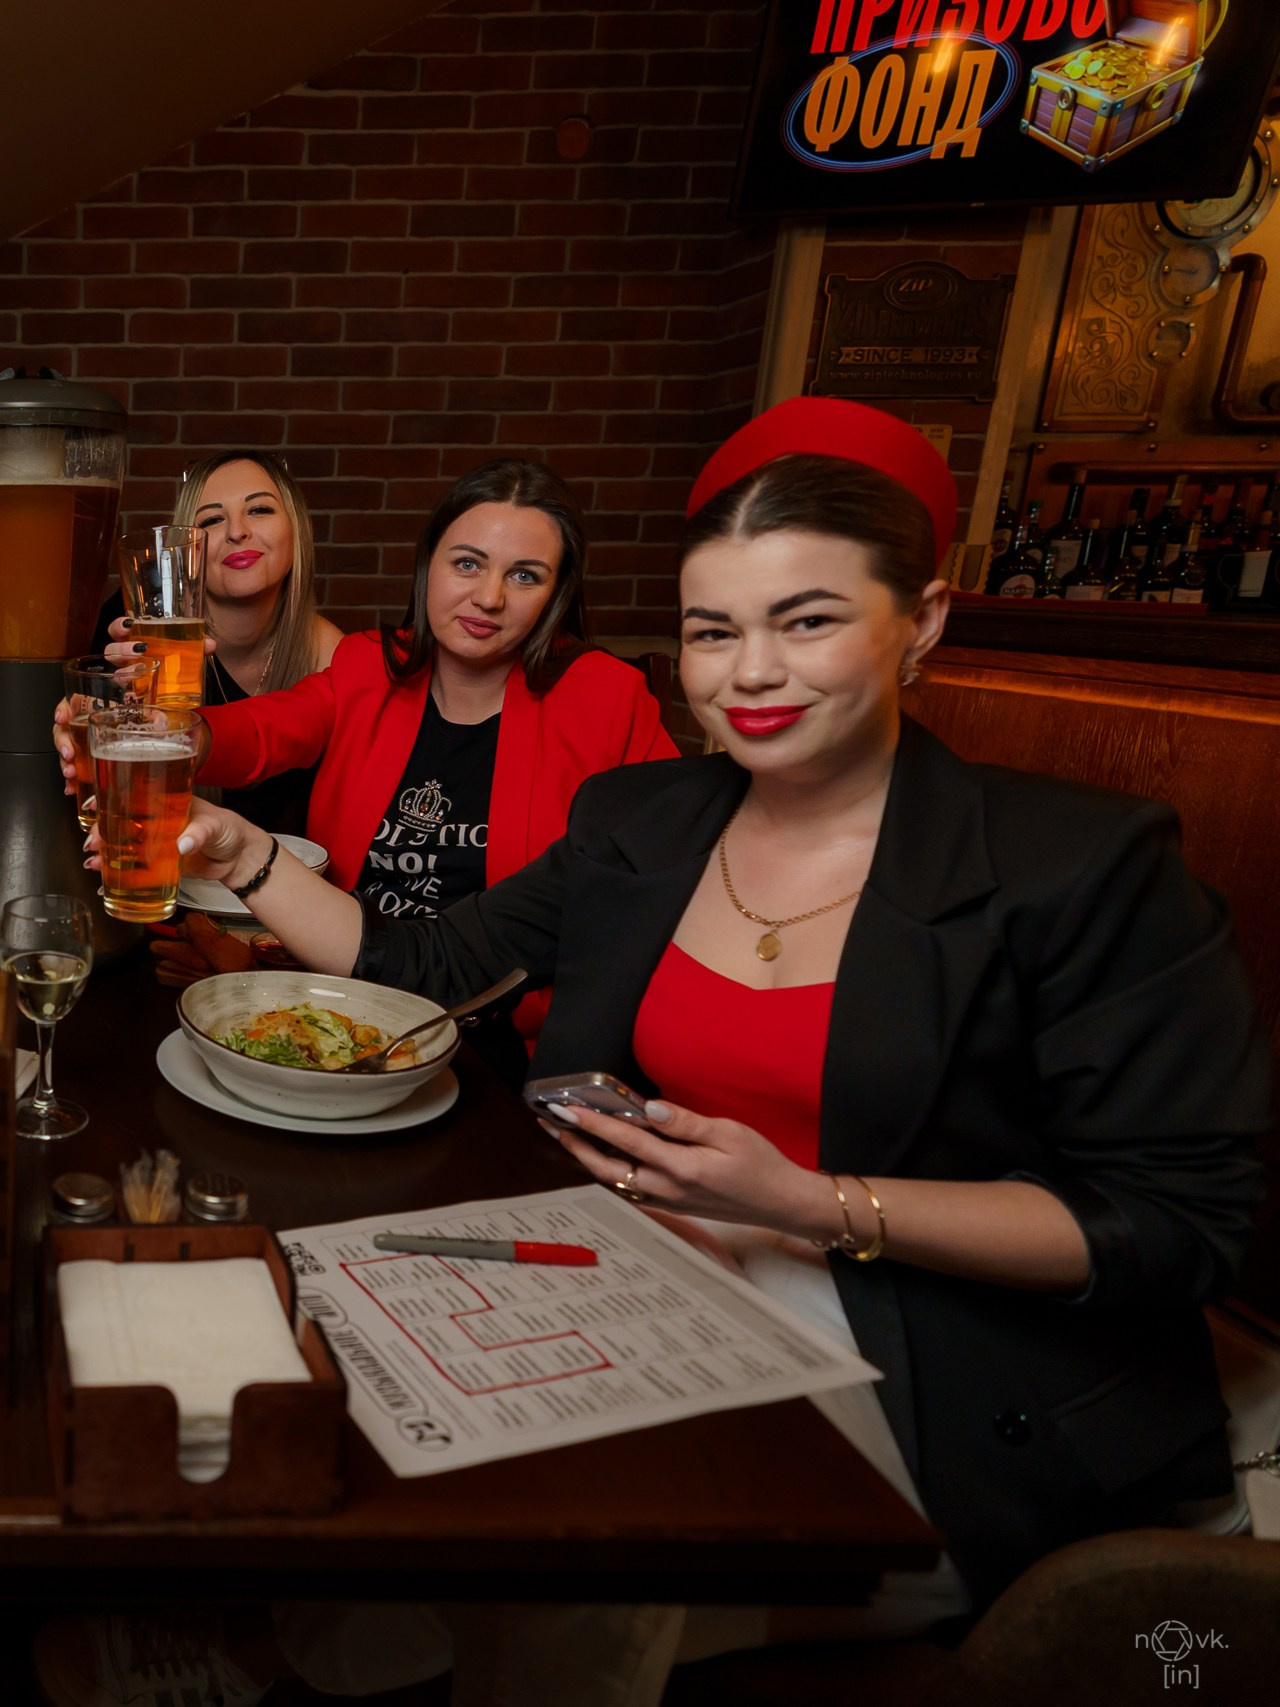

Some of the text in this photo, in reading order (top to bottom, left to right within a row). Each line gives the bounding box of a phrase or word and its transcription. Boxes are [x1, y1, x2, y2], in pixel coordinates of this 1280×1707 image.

[803, 50, 998, 160] ФОНД
[852, 348, 967, 363] SINCE 1993
[368, 850, 438, 874] NO!
